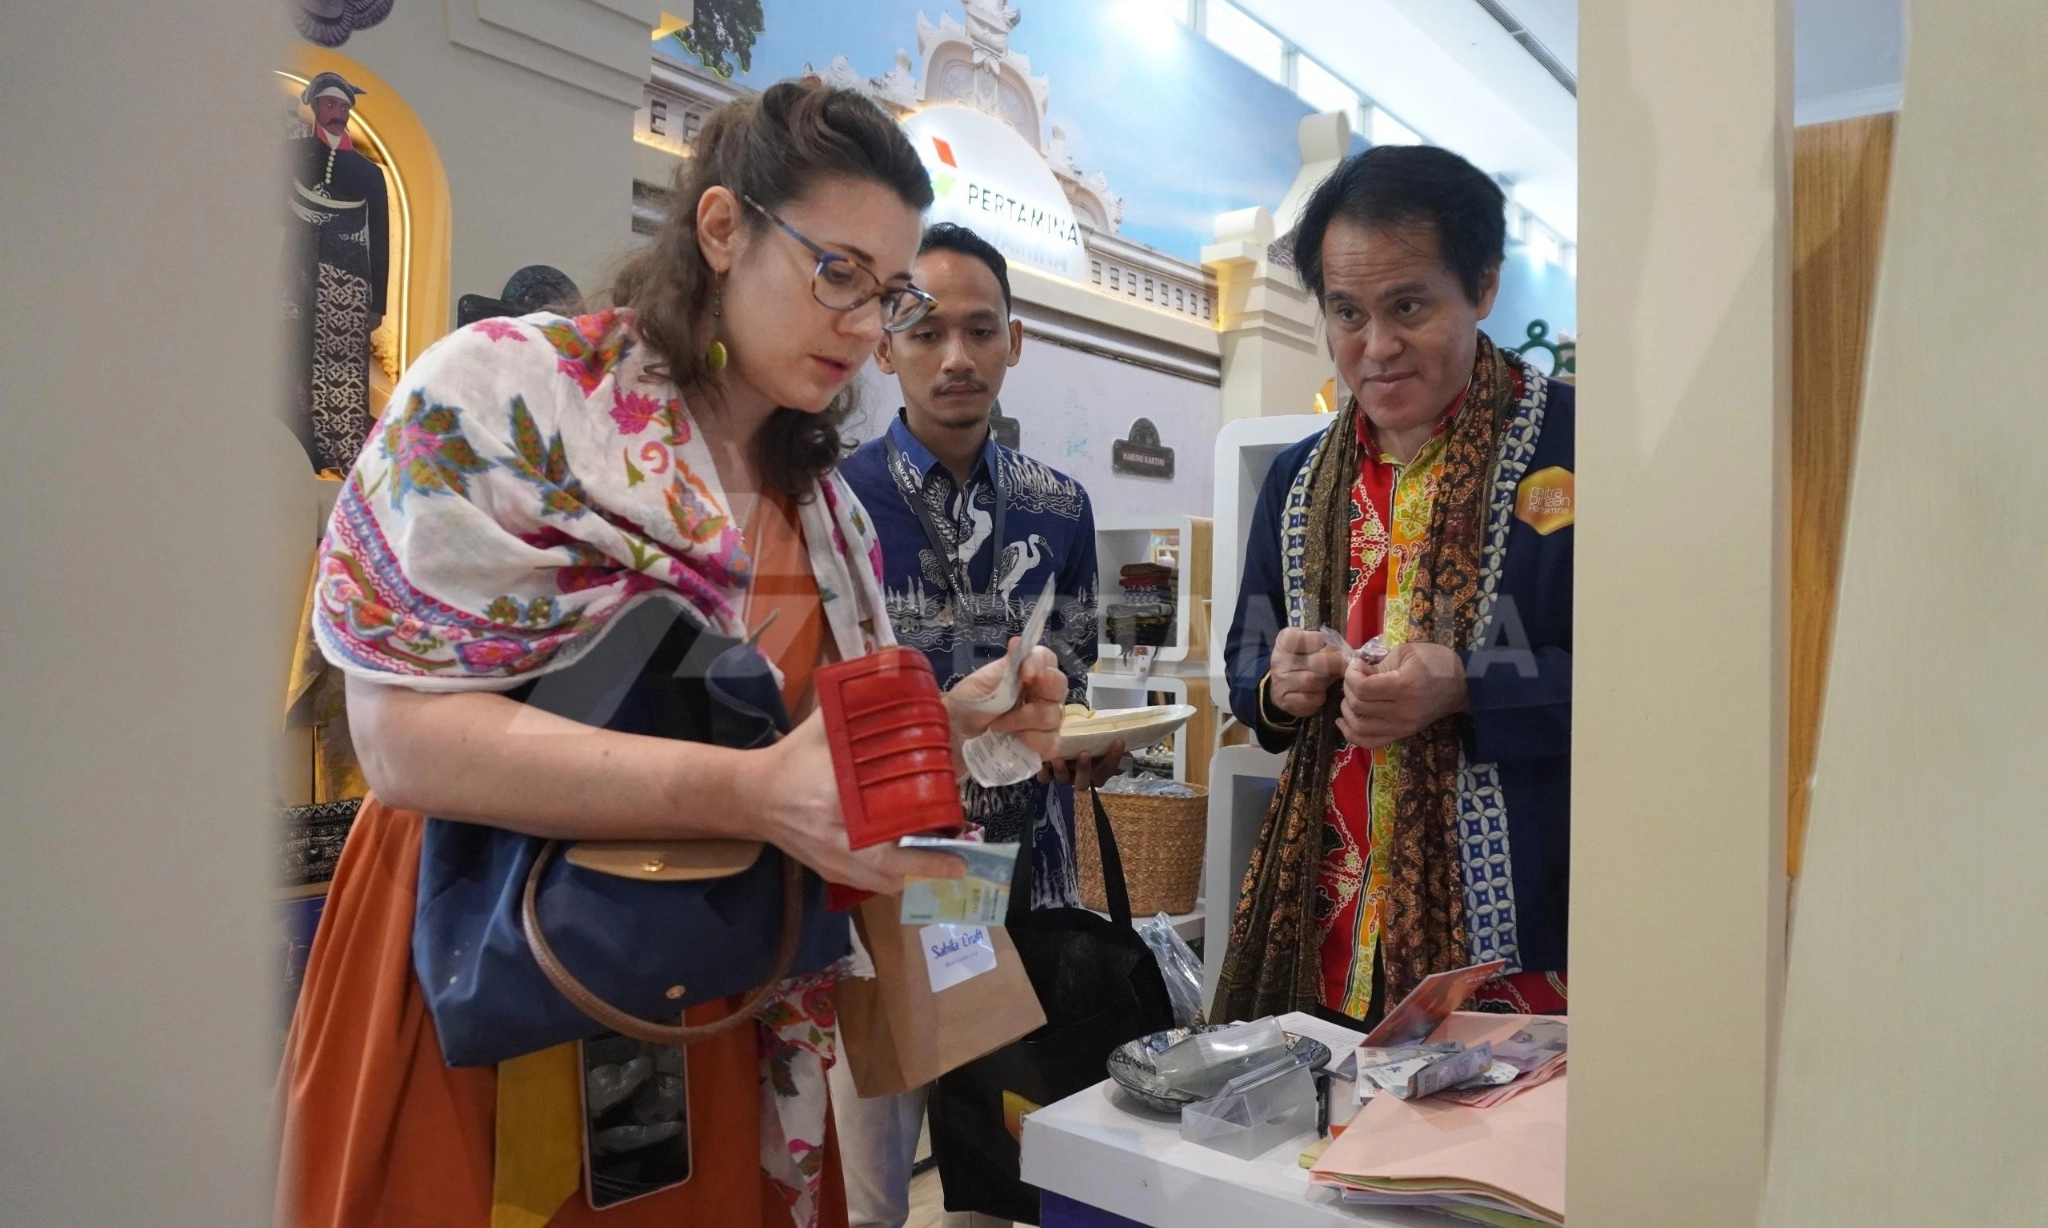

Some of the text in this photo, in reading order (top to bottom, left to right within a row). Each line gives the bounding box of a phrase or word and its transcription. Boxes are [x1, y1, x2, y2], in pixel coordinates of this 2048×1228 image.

[968, 182, 1078, 246] PERTAMINA
[895, 460, 917, 494] INACRAFT
[949, 573, 970, 611] INACRAFT
[961, 929, 984, 948] Craft
